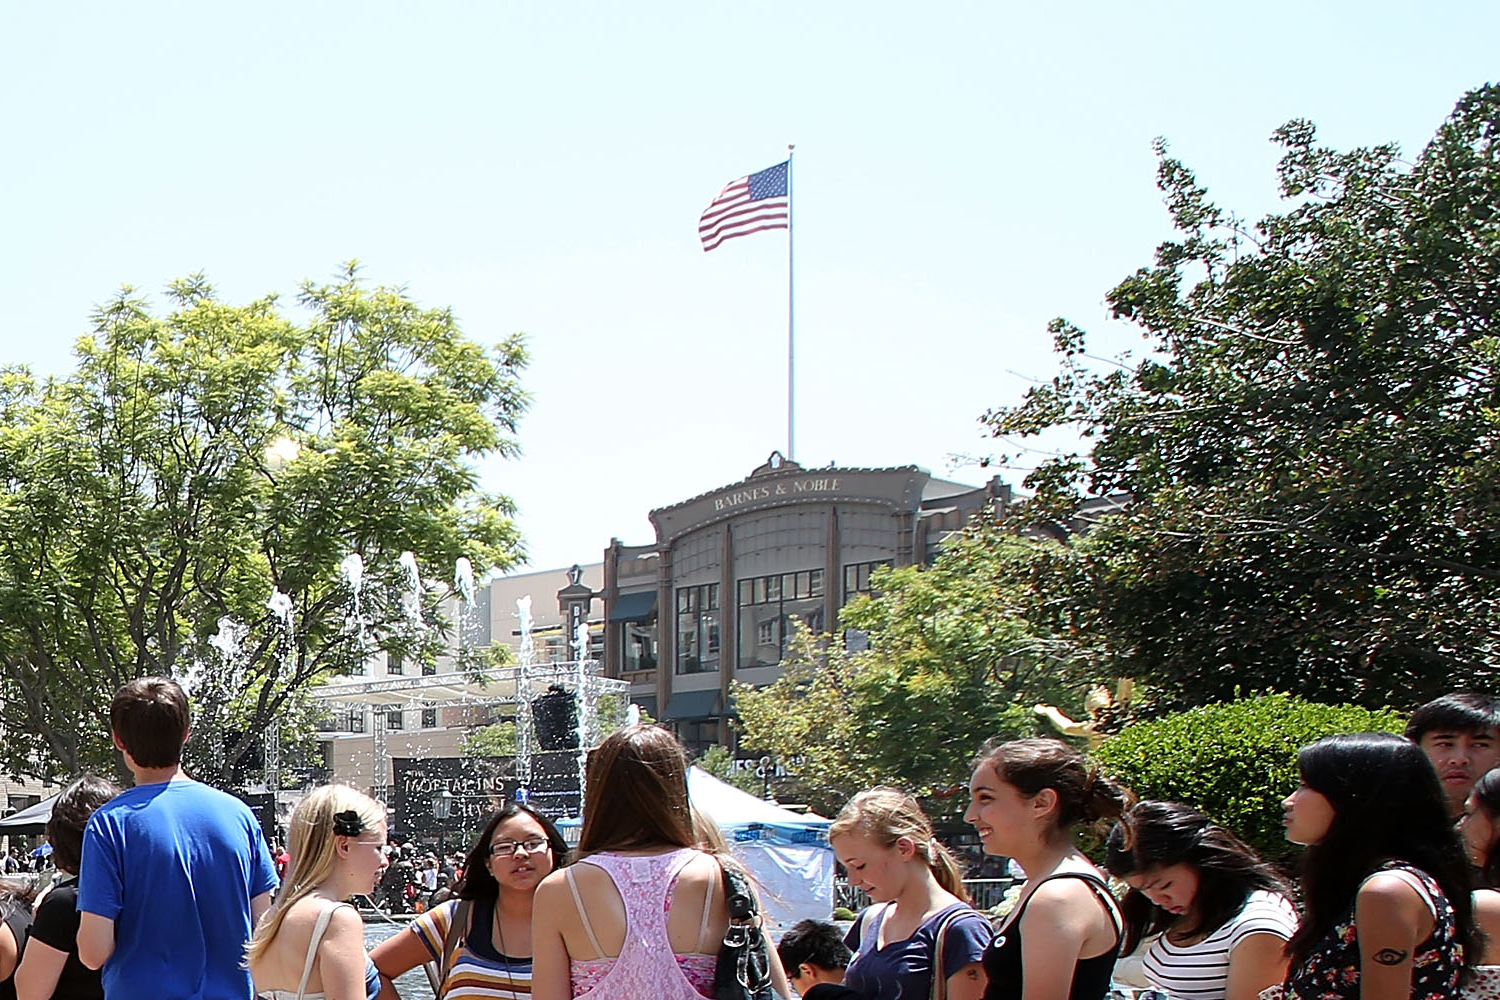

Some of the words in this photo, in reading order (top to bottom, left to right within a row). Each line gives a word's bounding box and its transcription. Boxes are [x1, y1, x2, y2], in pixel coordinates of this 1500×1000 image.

[715, 486, 769, 511] BARNES
[775, 484, 787, 495] &
[794, 478, 842, 493] NOBLE
